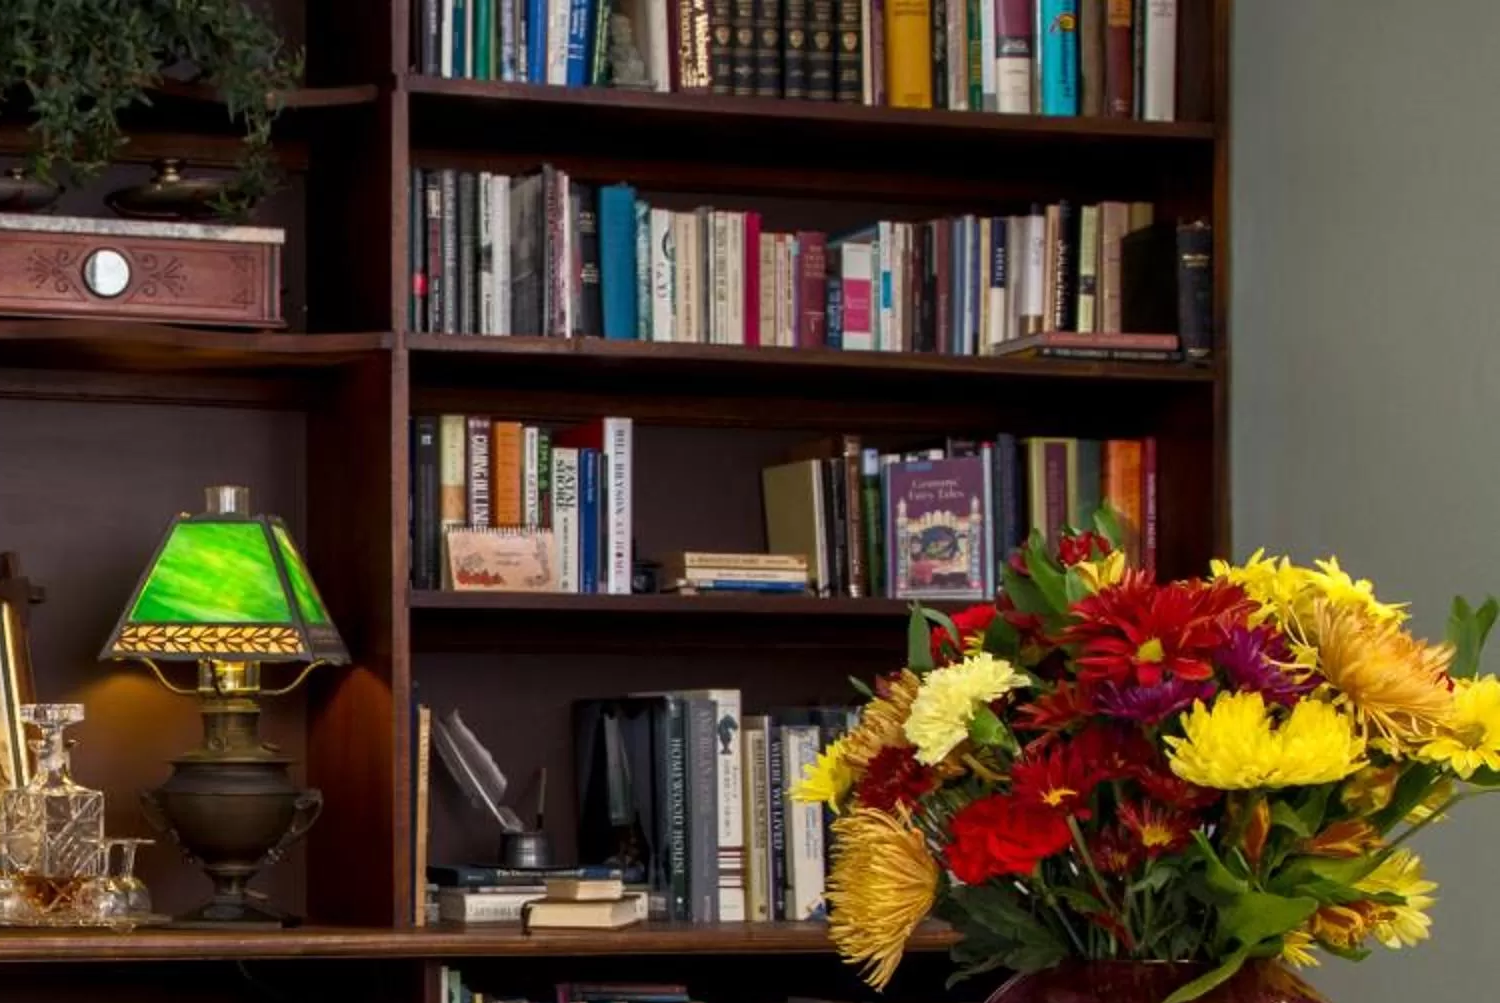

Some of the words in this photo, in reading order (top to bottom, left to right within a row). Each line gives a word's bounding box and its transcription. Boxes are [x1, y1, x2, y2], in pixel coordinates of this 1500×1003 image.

[471, 435, 489, 478] COMING
[614, 429, 625, 457] BILL
[555, 459, 566, 512] SHORE
[614, 463, 625, 515] BRYSON
[771, 741, 782, 783] WHERE
[672, 829, 685, 875] HOUSE
